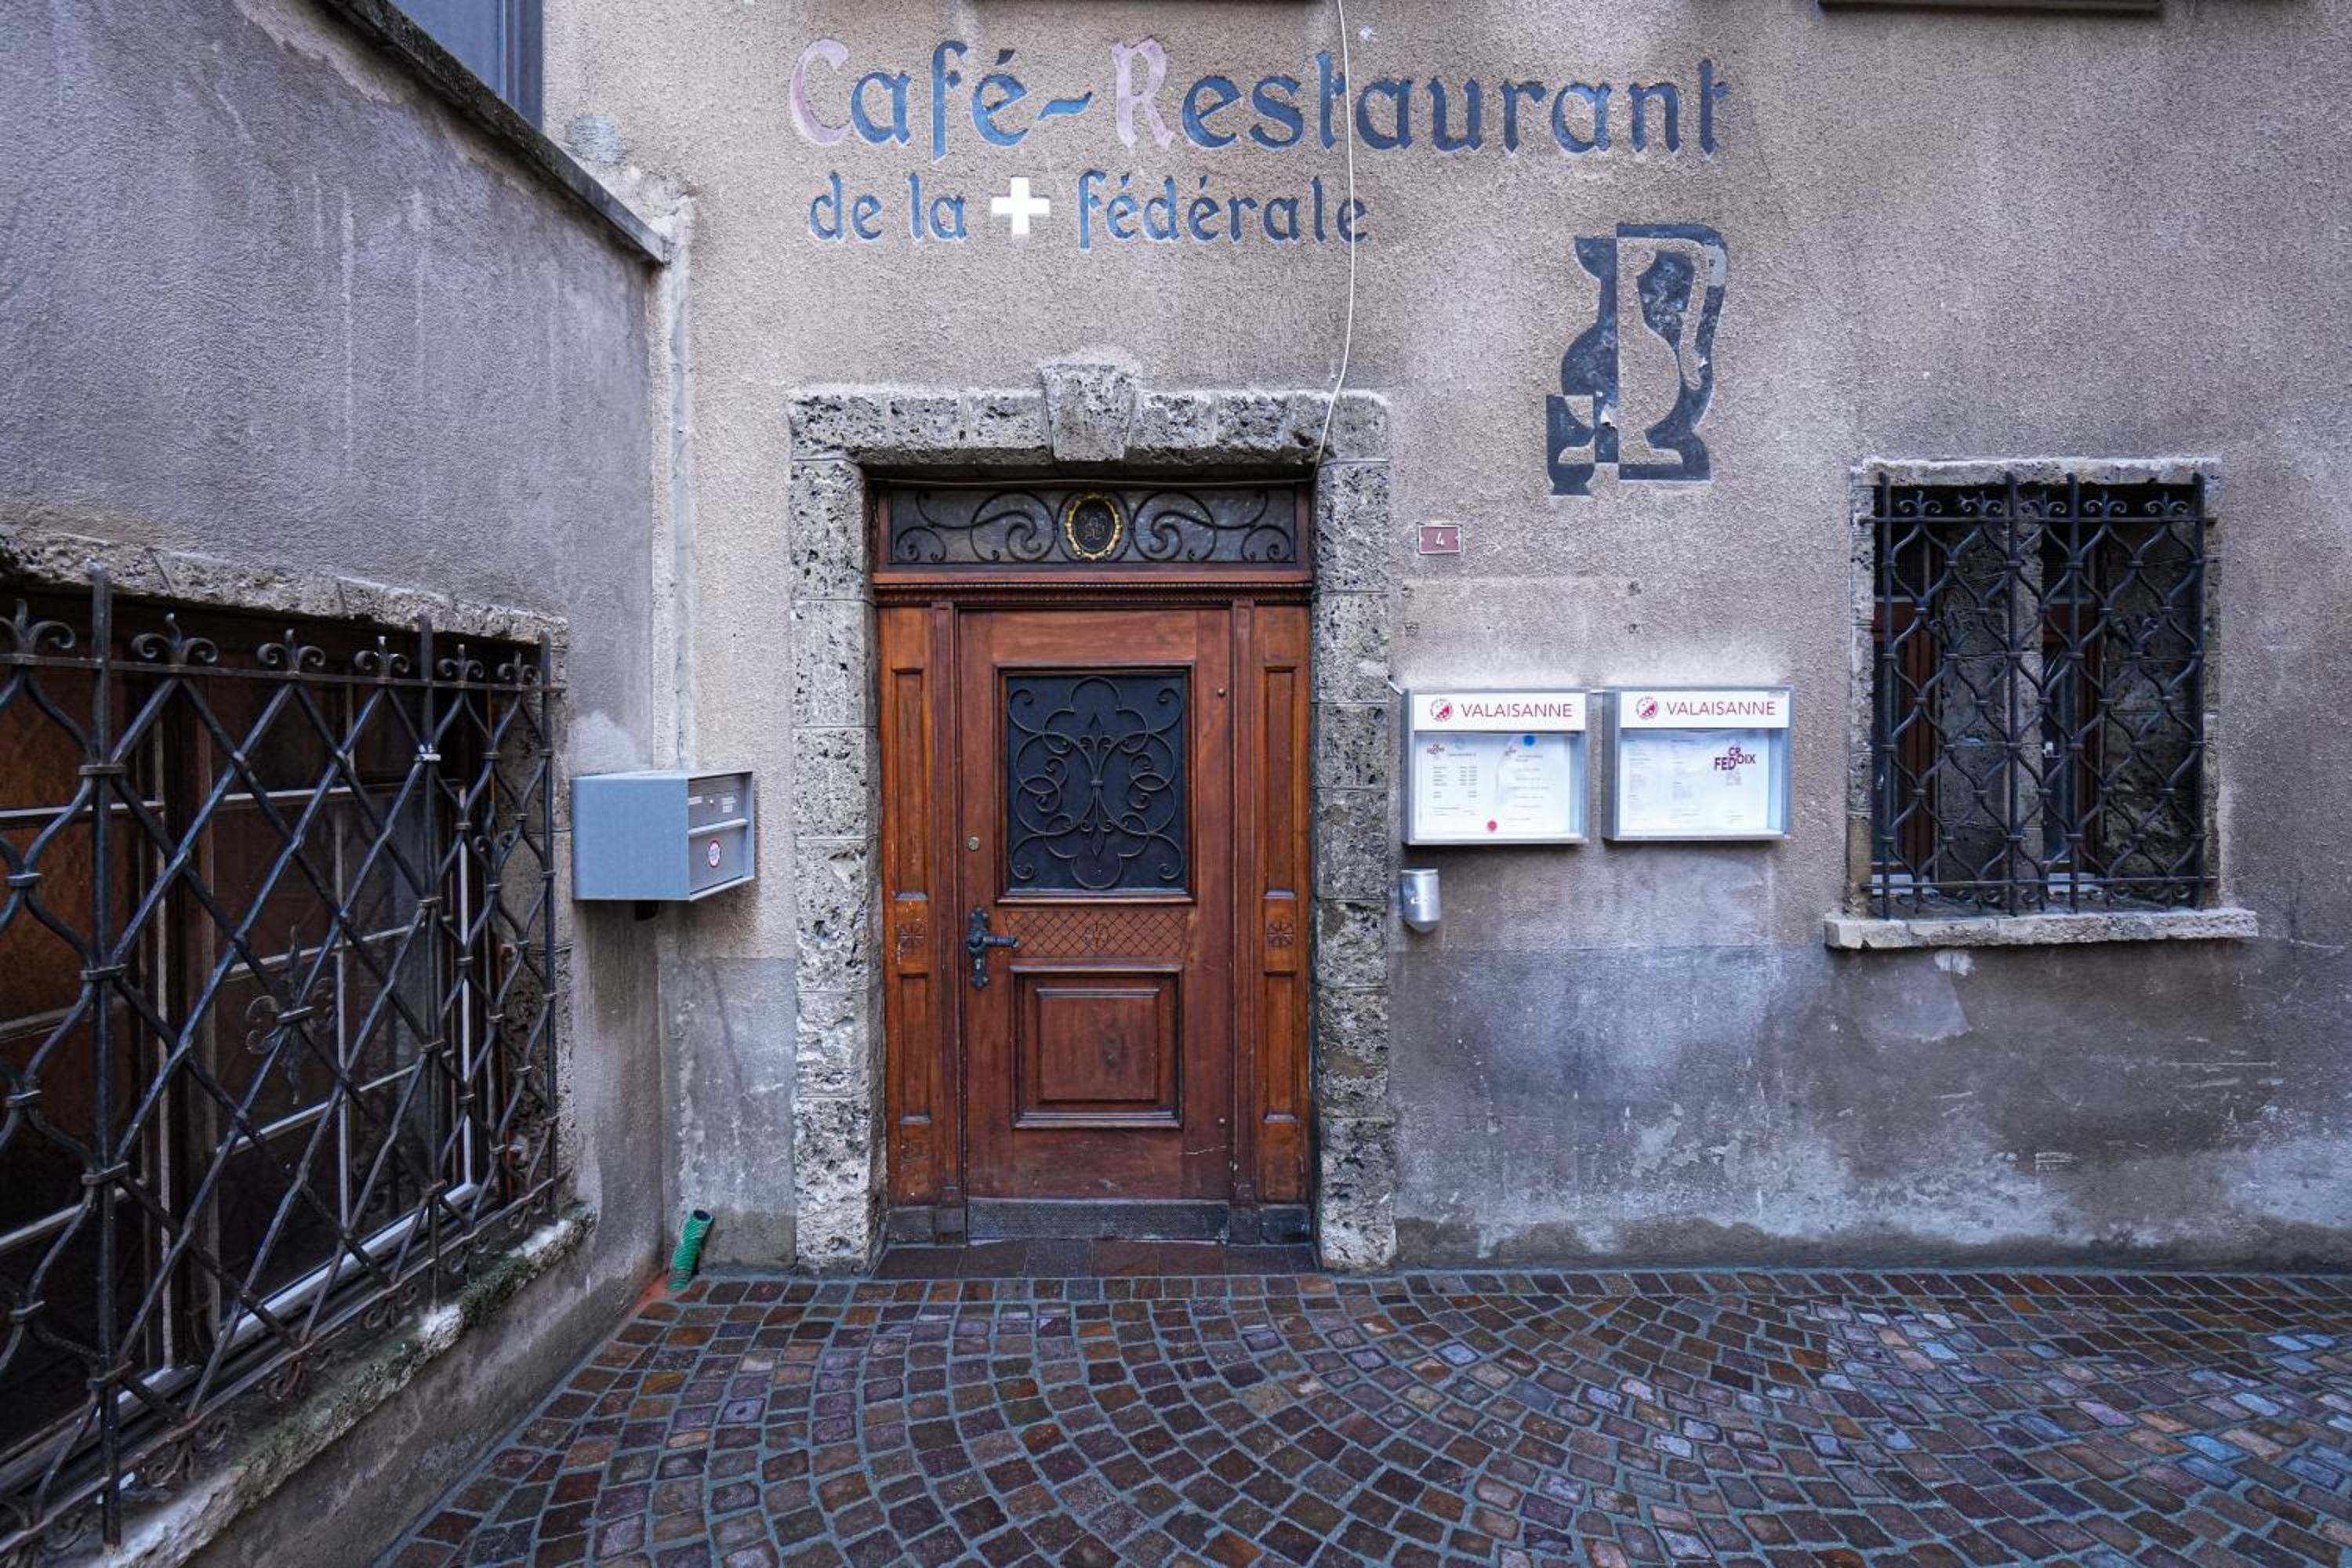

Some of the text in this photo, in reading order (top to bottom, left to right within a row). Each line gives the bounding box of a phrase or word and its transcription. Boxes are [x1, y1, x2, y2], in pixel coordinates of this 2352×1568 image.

[810, 169, 1367, 250] de la fédérale
[1436, 531, 1445, 546] 4
[1461, 703, 1573, 717] VALAISANNE
[1667, 701, 1776, 716] VALAISANNE
